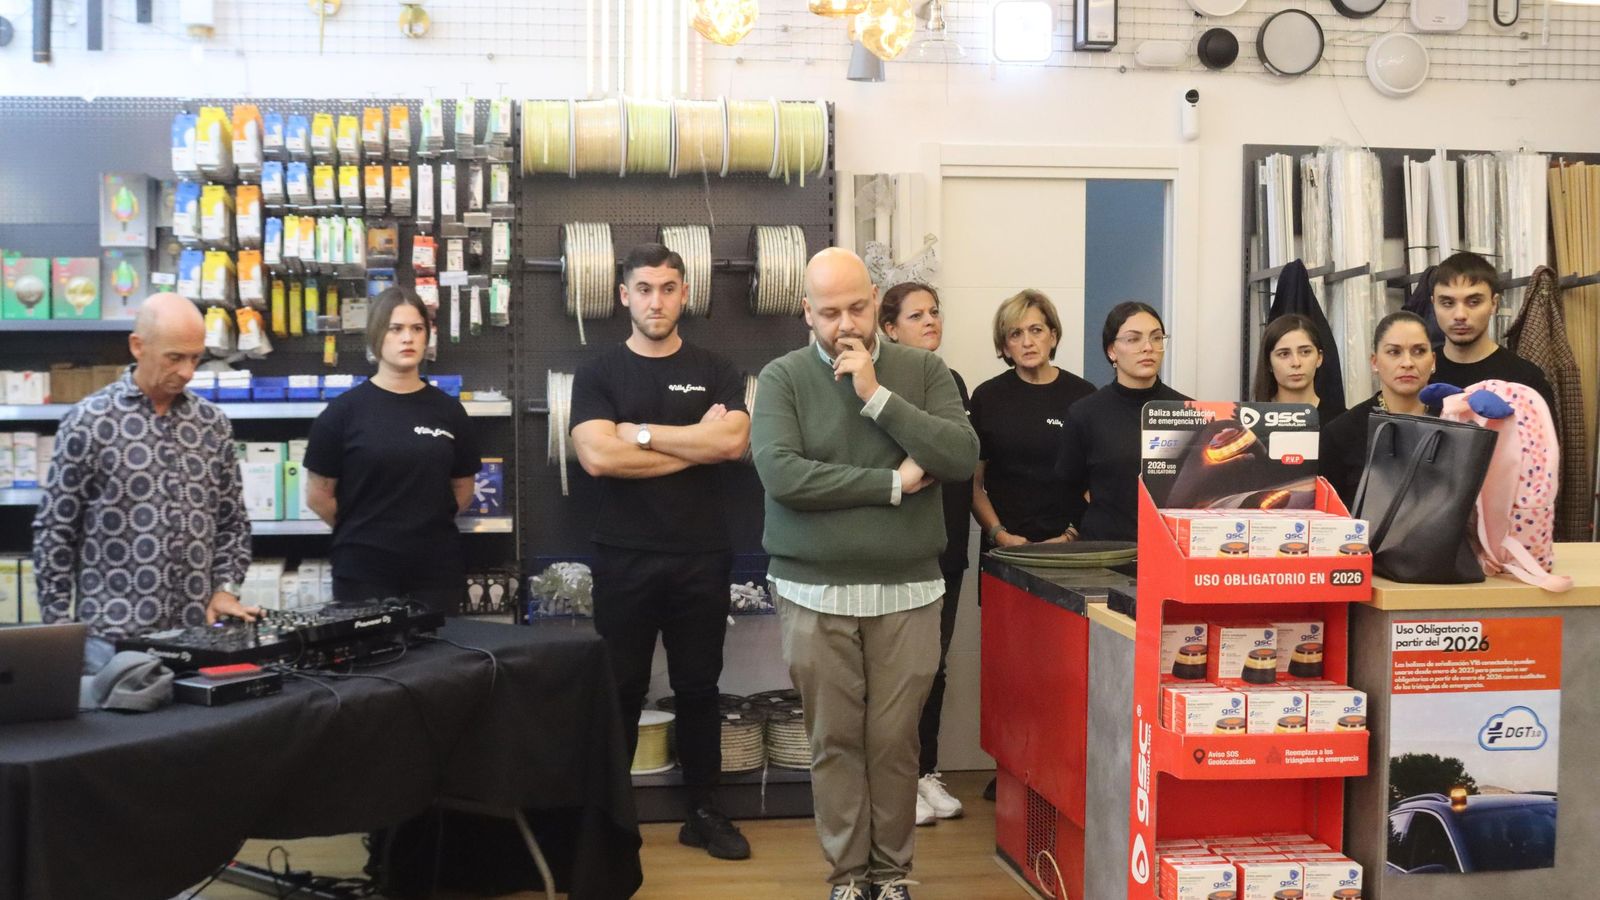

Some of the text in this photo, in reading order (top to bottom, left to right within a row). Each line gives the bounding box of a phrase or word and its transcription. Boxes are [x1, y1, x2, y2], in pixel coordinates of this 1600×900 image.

[1158, 418, 1194, 426] emergencia
[1264, 412, 1306, 426] gsc
[1226, 532, 1244, 540] gsc
[1194, 572, 1362, 586] USO OBLIGATORIO EN 2026
[1396, 625, 1413, 634] Uso
[1416, 624, 1470, 636] Obligatorio
[1300, 634, 1318, 642] gsc
[1396, 635, 1490, 652] partir del 2026
[1221, 708, 1240, 716] gsc
[1283, 706, 1301, 714] gsc
[1343, 706, 1361, 714] gsc
[1505, 727, 1533, 738] DGT
[1226, 750, 1239, 758] SOS
[1285, 749, 1318, 757] Reemplaza
[1208, 758, 1256, 766] Geolocalización
[1285, 756, 1315, 764] triángulos
[1325, 755, 1359, 763] emergencia
[1137, 719, 1148, 826] gsc
[1213, 881, 1232, 889] gsc
